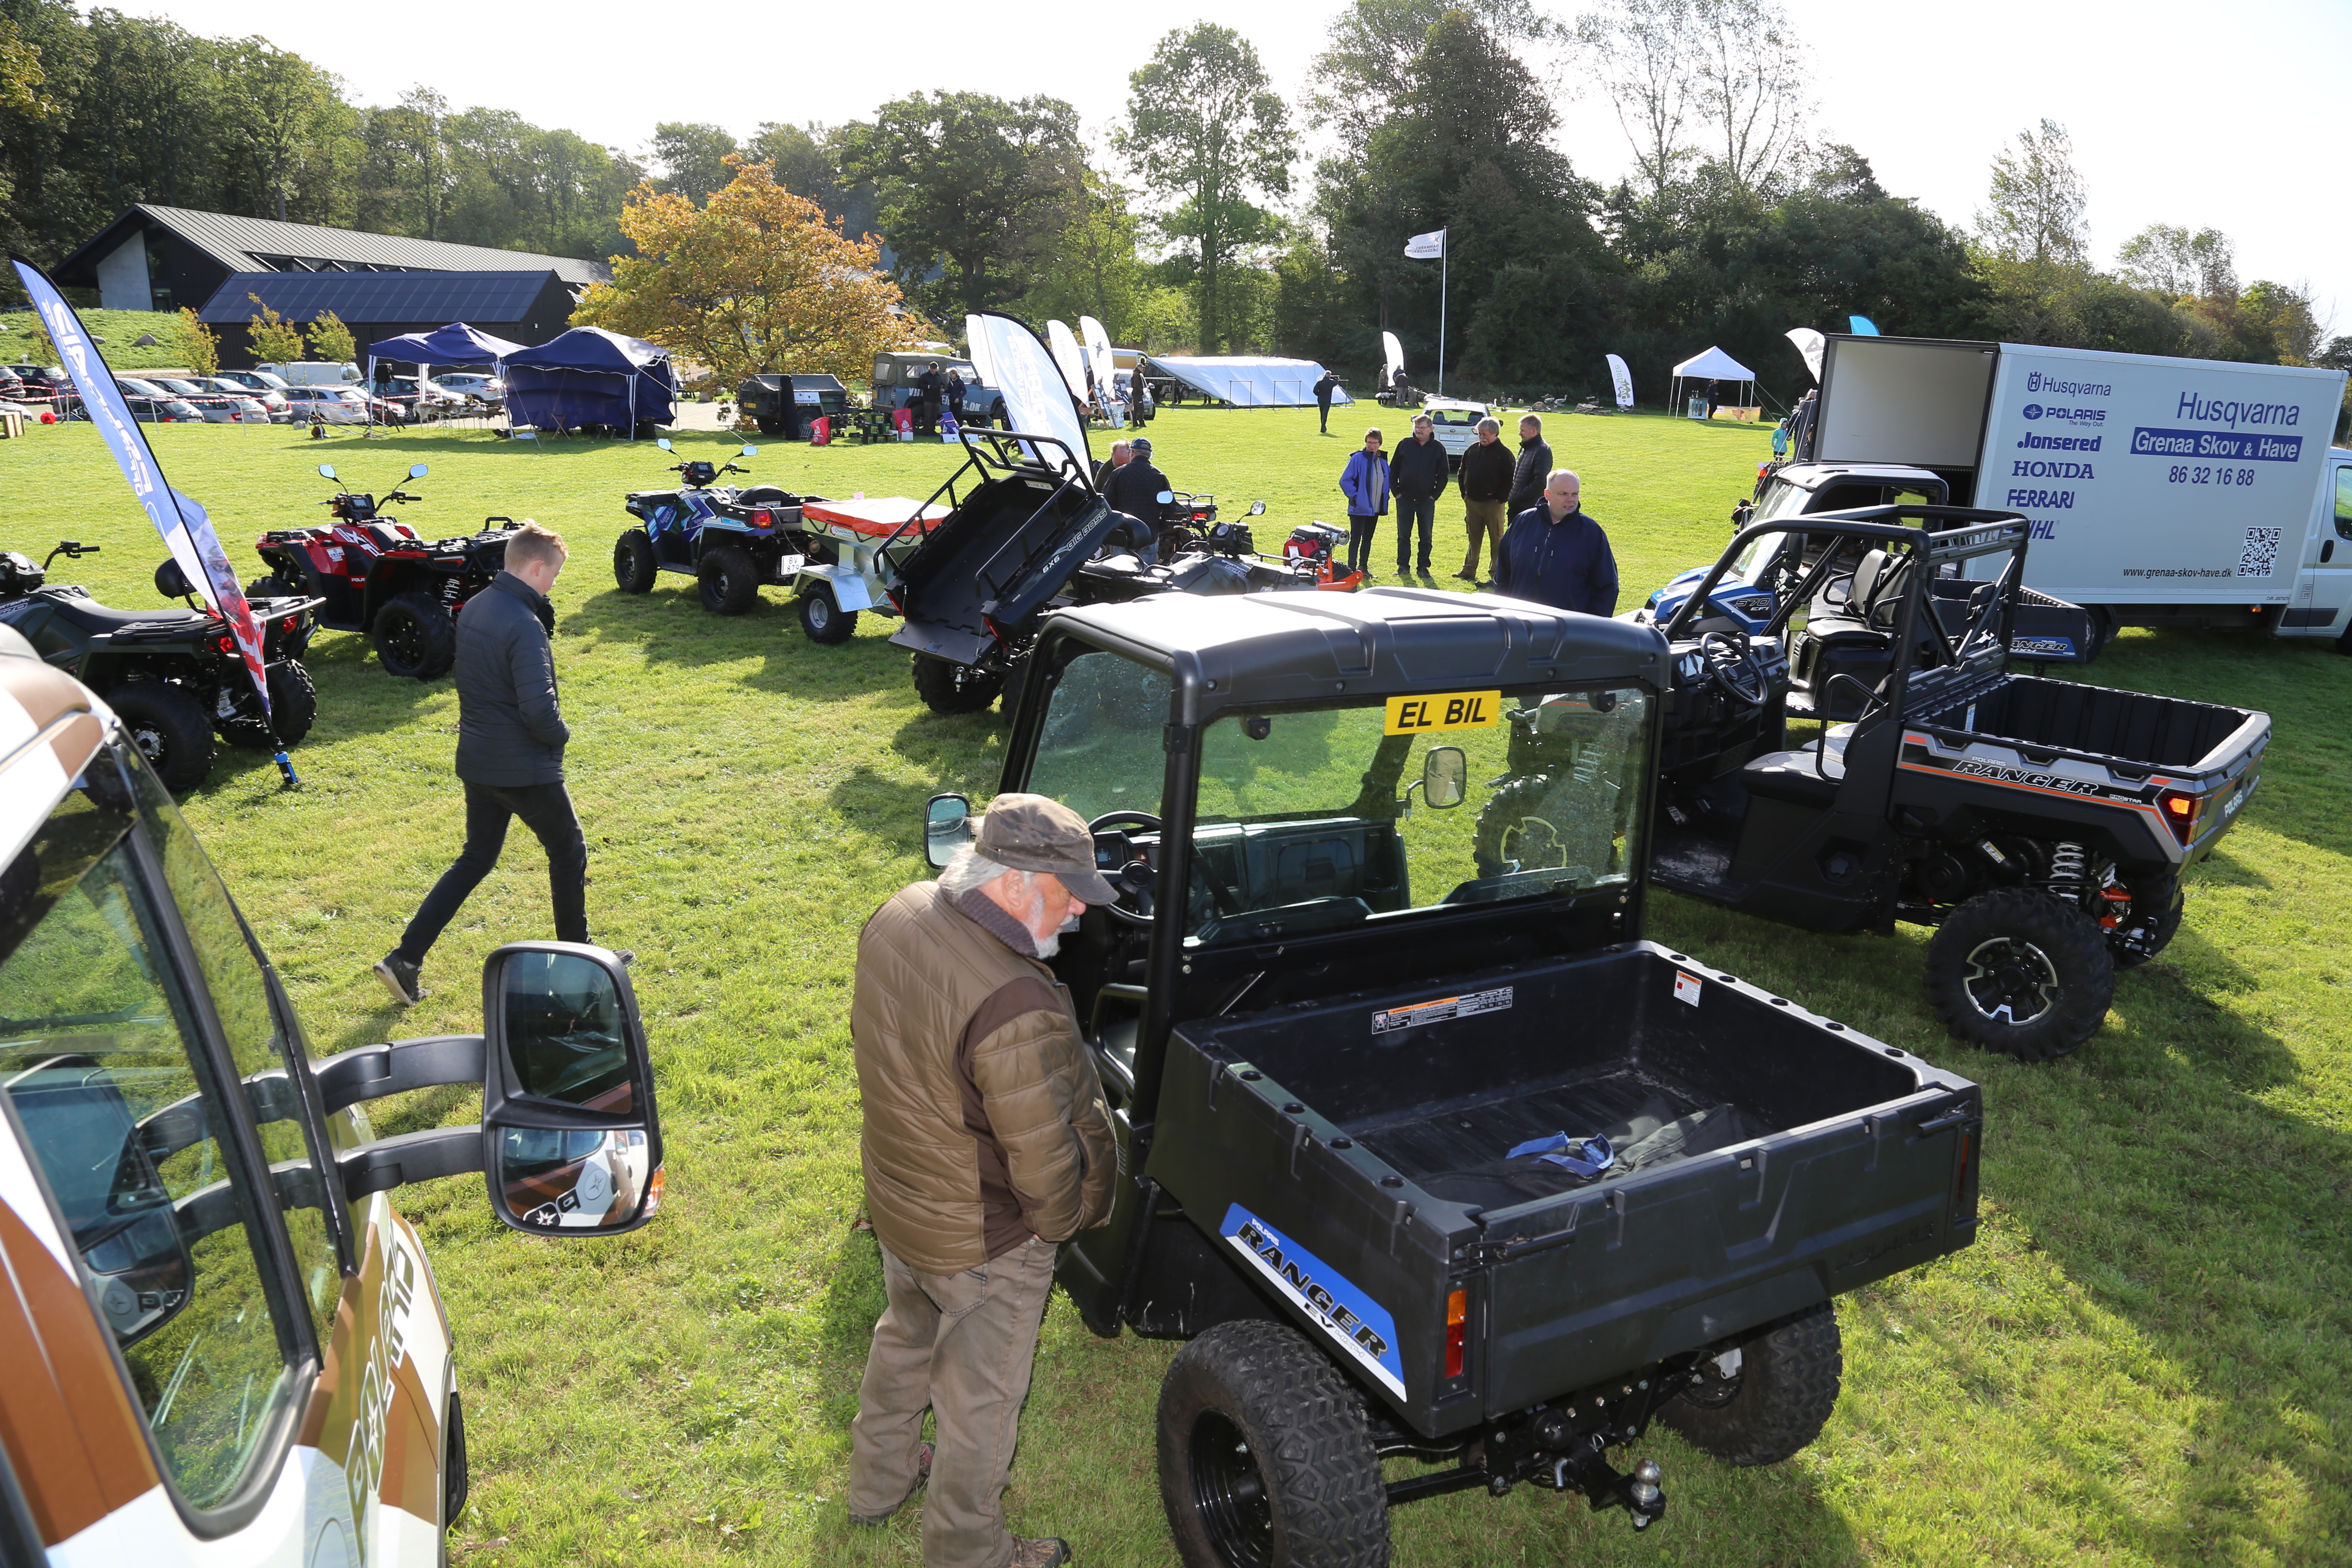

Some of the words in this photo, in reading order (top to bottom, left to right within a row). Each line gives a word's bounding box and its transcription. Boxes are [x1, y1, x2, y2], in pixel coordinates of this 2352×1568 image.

[2043, 377, 2111, 398] Husqvarna
[2046, 407, 2106, 421] POLARIS
[2177, 391, 2300, 429] Husqvarna
[2135, 431, 2194, 453] Grenaa
[2198, 434, 2240, 456] Skov
[2243, 442, 2253, 456] &
[2257, 438, 2298, 458] Have
[2012, 460, 2095, 479] HONDA
[2169, 465, 2188, 484] 86
[2192, 466, 2211, 484] 32
[2216, 467, 2233, 486] 16
[2236, 469, 2255, 487] 88
[2007, 489, 2075, 508] FERRARI
[337, 529, 351, 541] 1000
[1066, 531, 1083, 551] BIG
[1082, 508, 1107, 536] BOSS
[2123, 567, 2232, 579] www.grenaa-skov-have.dk
[1734, 598, 1770, 607] 570
[2010, 640, 2068, 651] ANGER
[1398, 701, 1433, 729] EL
[1444, 697, 1487, 725] BIL
[1972, 756, 2006, 766] POLARIS
[1952, 760, 2099, 796] RANGER
[2110, 794, 2142, 804] PROSTAR
[2224, 790, 2243, 818] POLARIS
[1251, 1217, 1280, 1247] POLARIS
[1237, 1221, 1388, 1360] RANGER
[1304, 1302, 1337, 1329] EV
